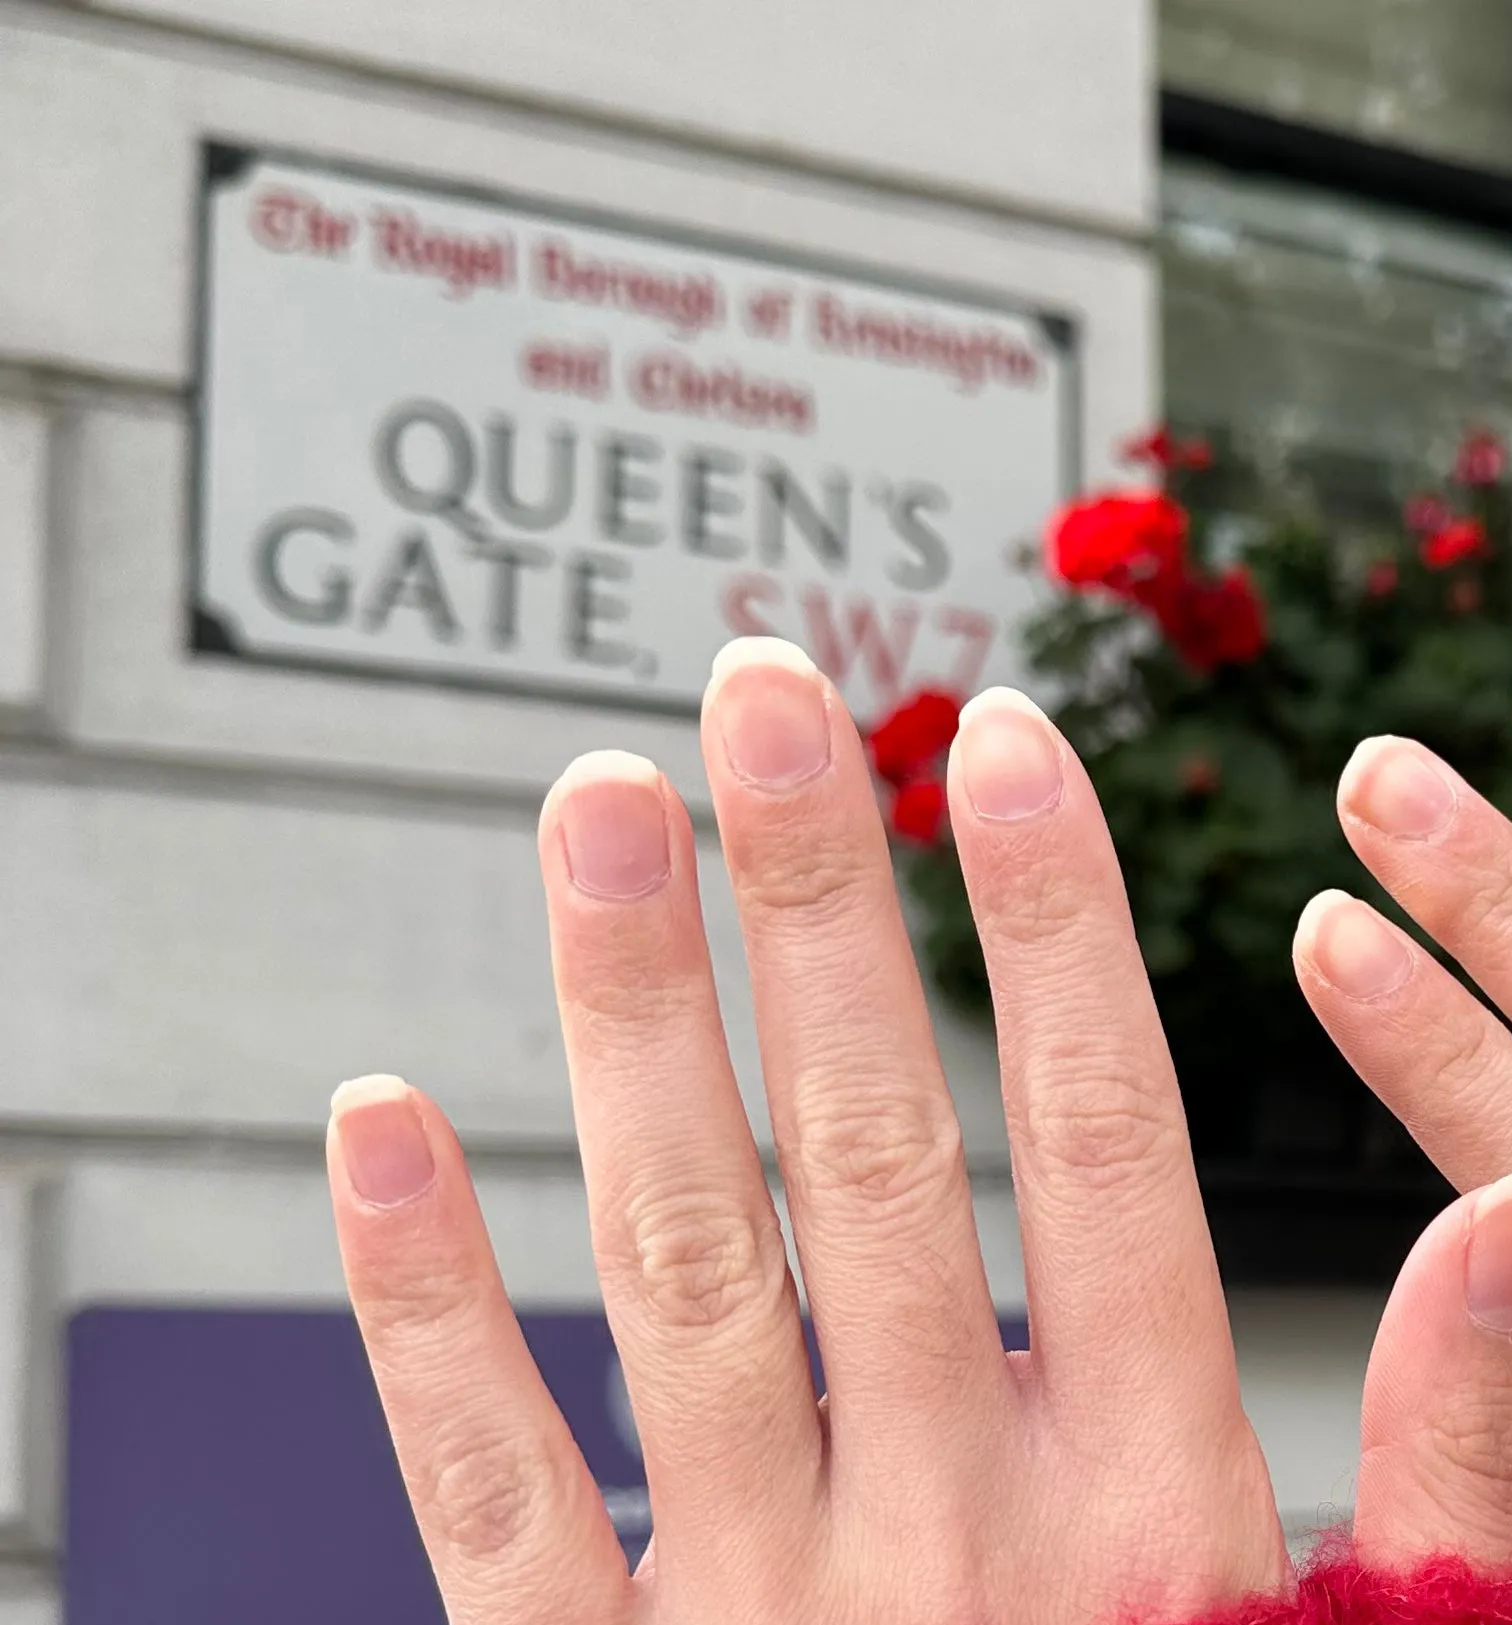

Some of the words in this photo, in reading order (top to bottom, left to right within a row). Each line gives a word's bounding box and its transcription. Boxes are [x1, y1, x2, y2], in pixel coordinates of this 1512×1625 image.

[252, 188, 353, 256] The
[374, 207, 516, 300] Royal
[534, 243, 724, 338] Borough
[744, 292, 792, 340] of
[521, 335, 610, 400] and
[376, 398, 953, 592] QUEEN'S
